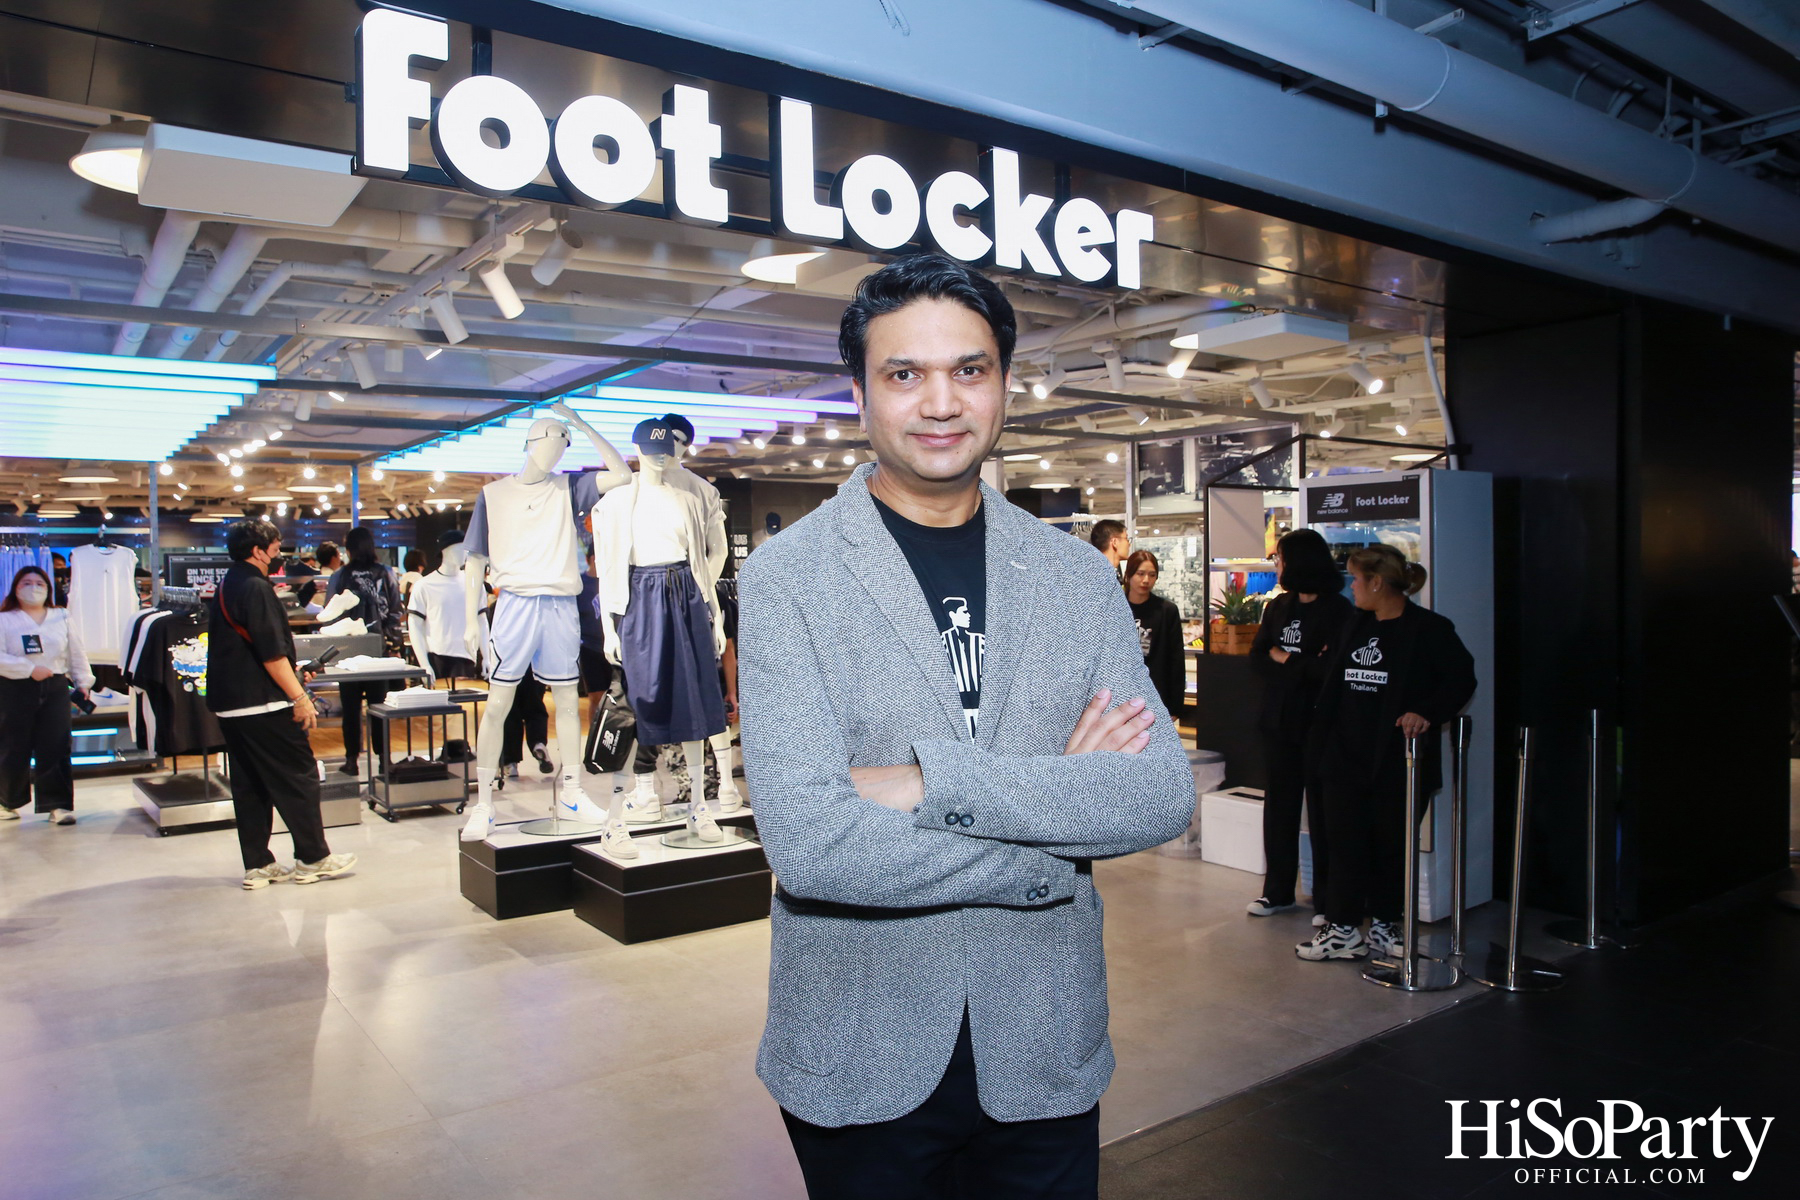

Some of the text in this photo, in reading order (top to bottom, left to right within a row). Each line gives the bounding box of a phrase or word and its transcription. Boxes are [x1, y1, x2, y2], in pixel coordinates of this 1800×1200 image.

[361, 8, 1155, 290] Foot Locker
[1355, 494, 1410, 507] Foot Locker
[187, 575, 215, 584] SINCE
[1361, 672, 1387, 682] Locker
